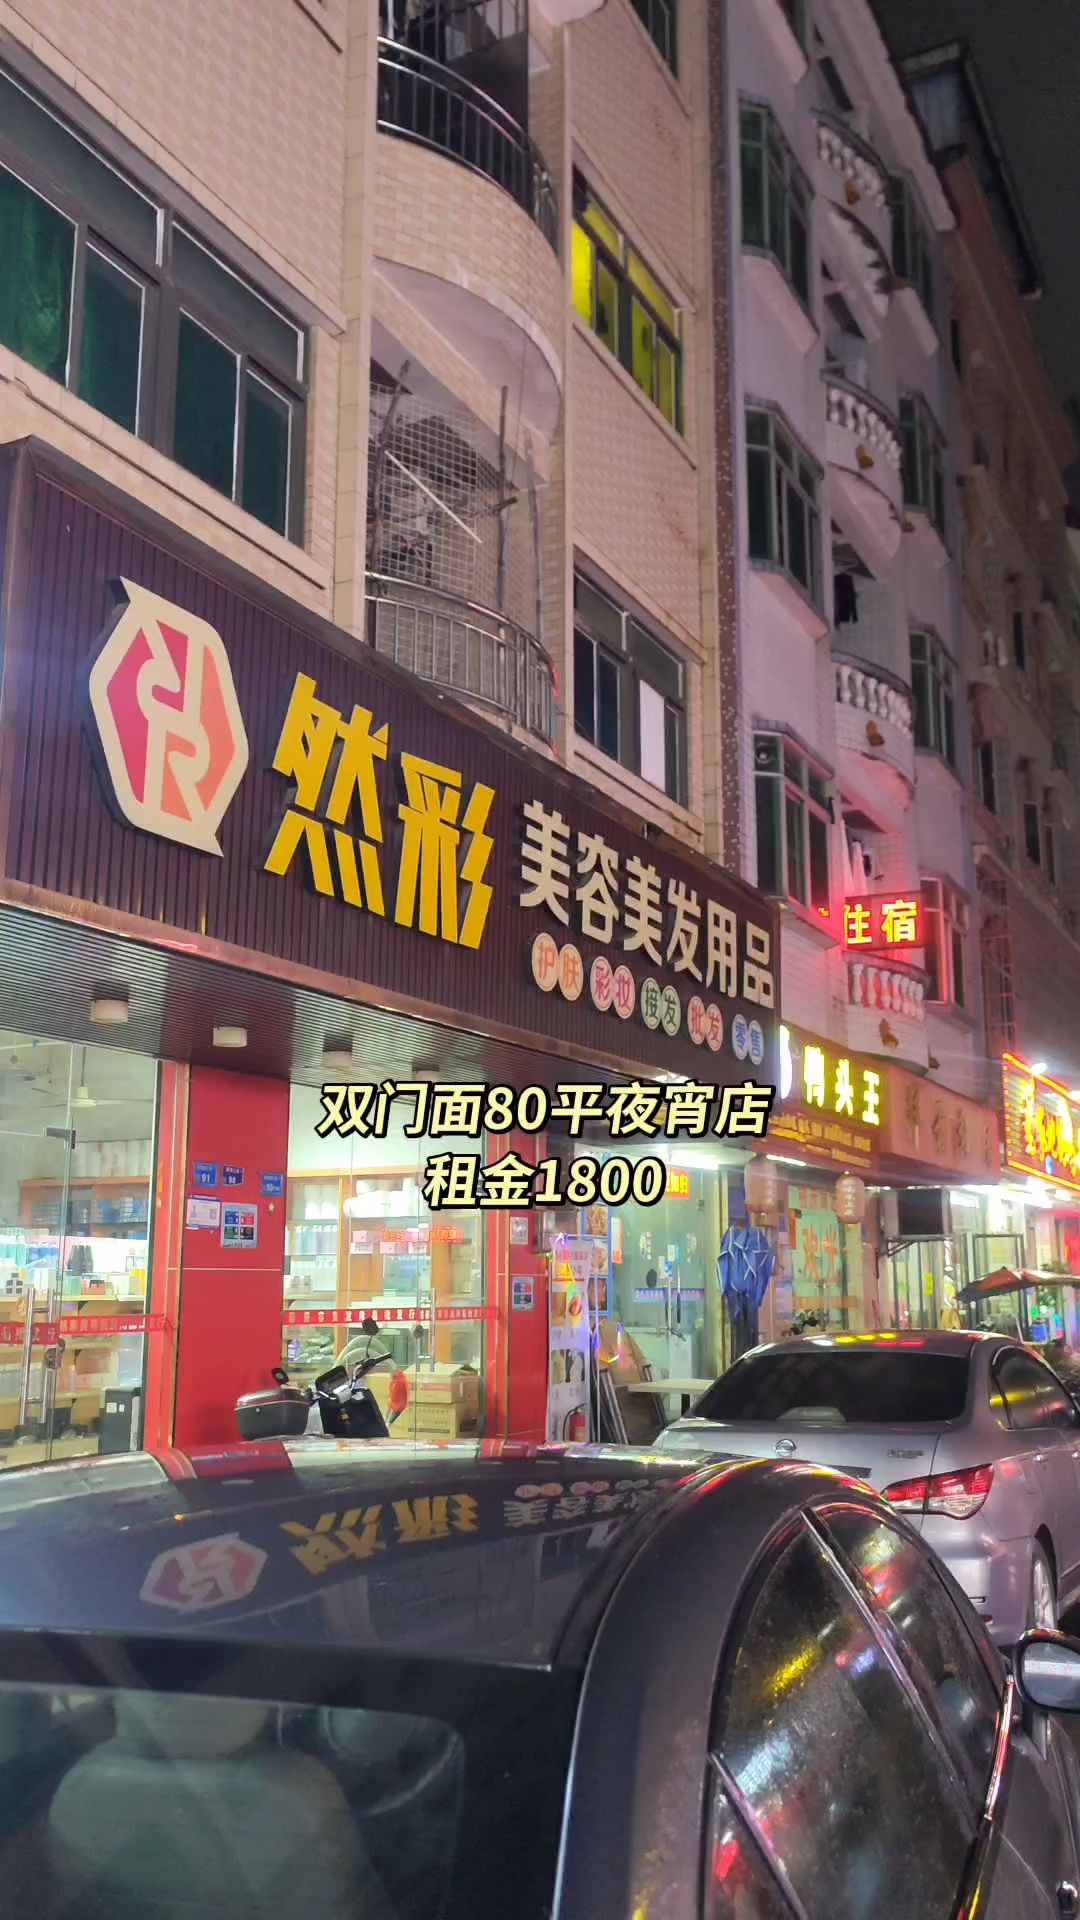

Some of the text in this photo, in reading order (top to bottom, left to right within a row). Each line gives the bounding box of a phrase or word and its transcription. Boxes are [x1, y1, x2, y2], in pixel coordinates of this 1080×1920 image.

[264, 672, 495, 949] 然彩
[520, 800, 774, 1008] 美容美发用品
[844, 899, 917, 944] 住宿
[536, 941, 579, 994] 护肤
[594, 964, 632, 1011] 彩妆
[643, 981, 677, 1032] 接发
[690, 1000, 721, 1043] 批发
